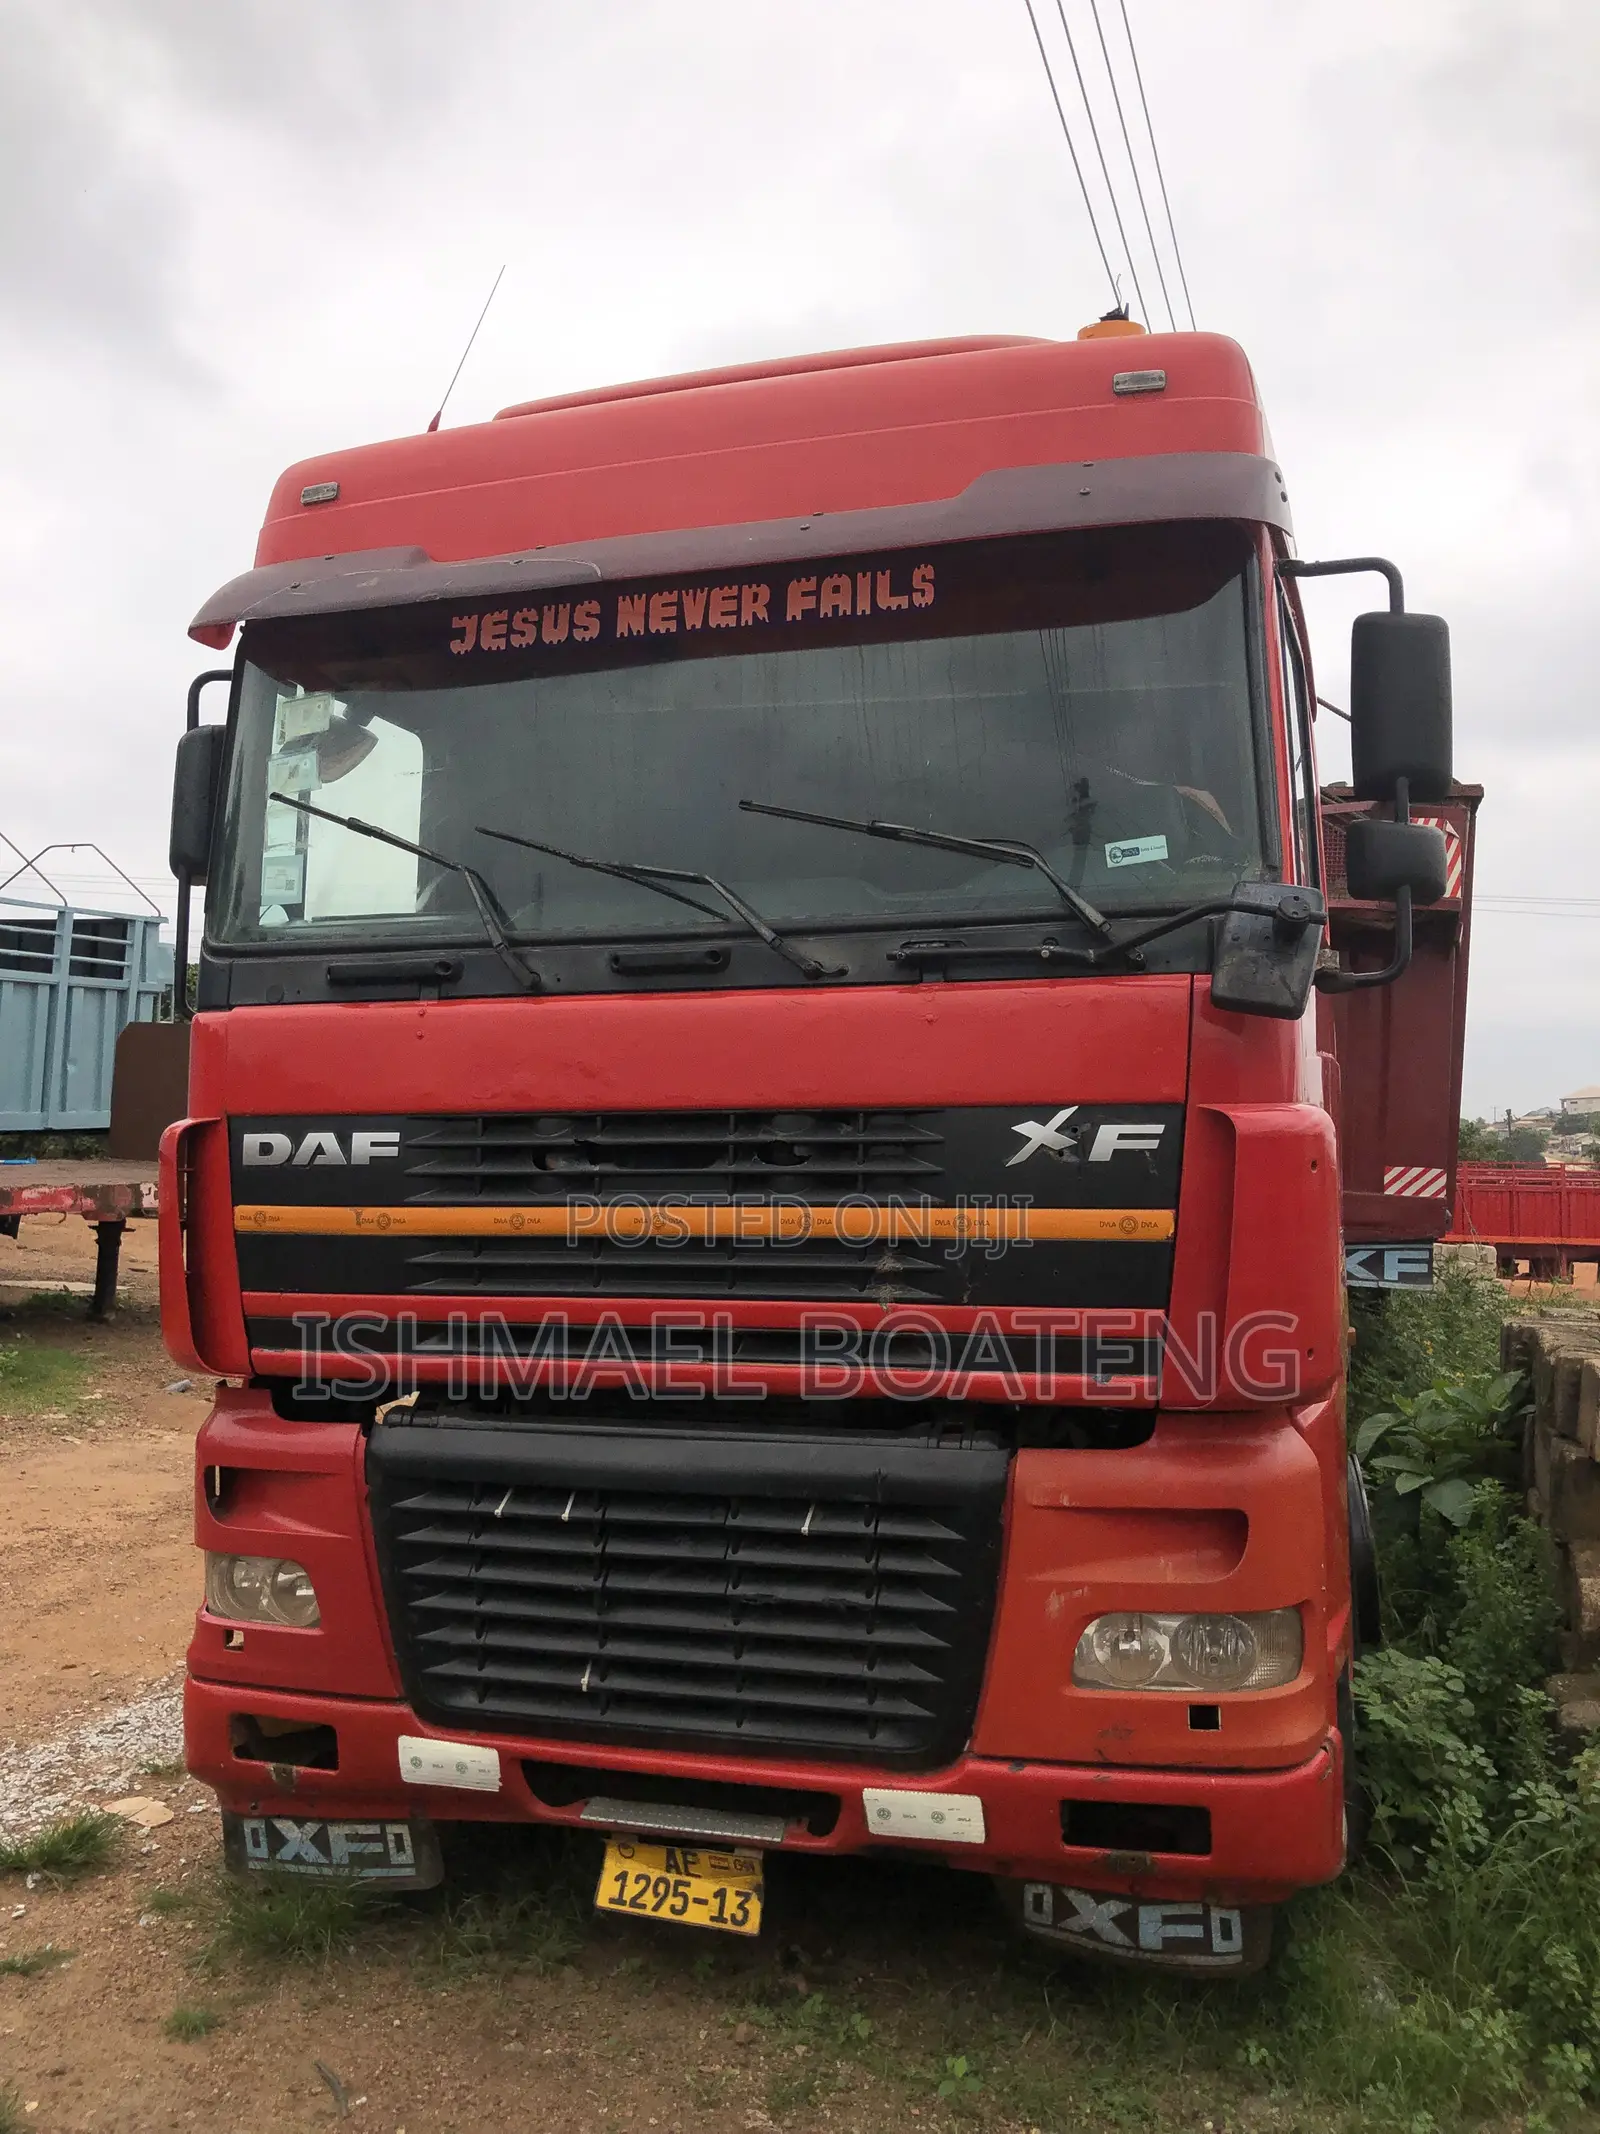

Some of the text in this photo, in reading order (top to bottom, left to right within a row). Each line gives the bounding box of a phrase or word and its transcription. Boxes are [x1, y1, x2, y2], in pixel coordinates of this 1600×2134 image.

[450, 563, 935, 655] JESUS NEVER FAILS
[242, 1131, 400, 1168] DAF
[1004, 1105, 1166, 1168] XF
[1099, 1220, 1159, 1229] DVLA DVLA
[665, 1847, 702, 1878] AE
[607, 1870, 753, 1928] 1295-13
